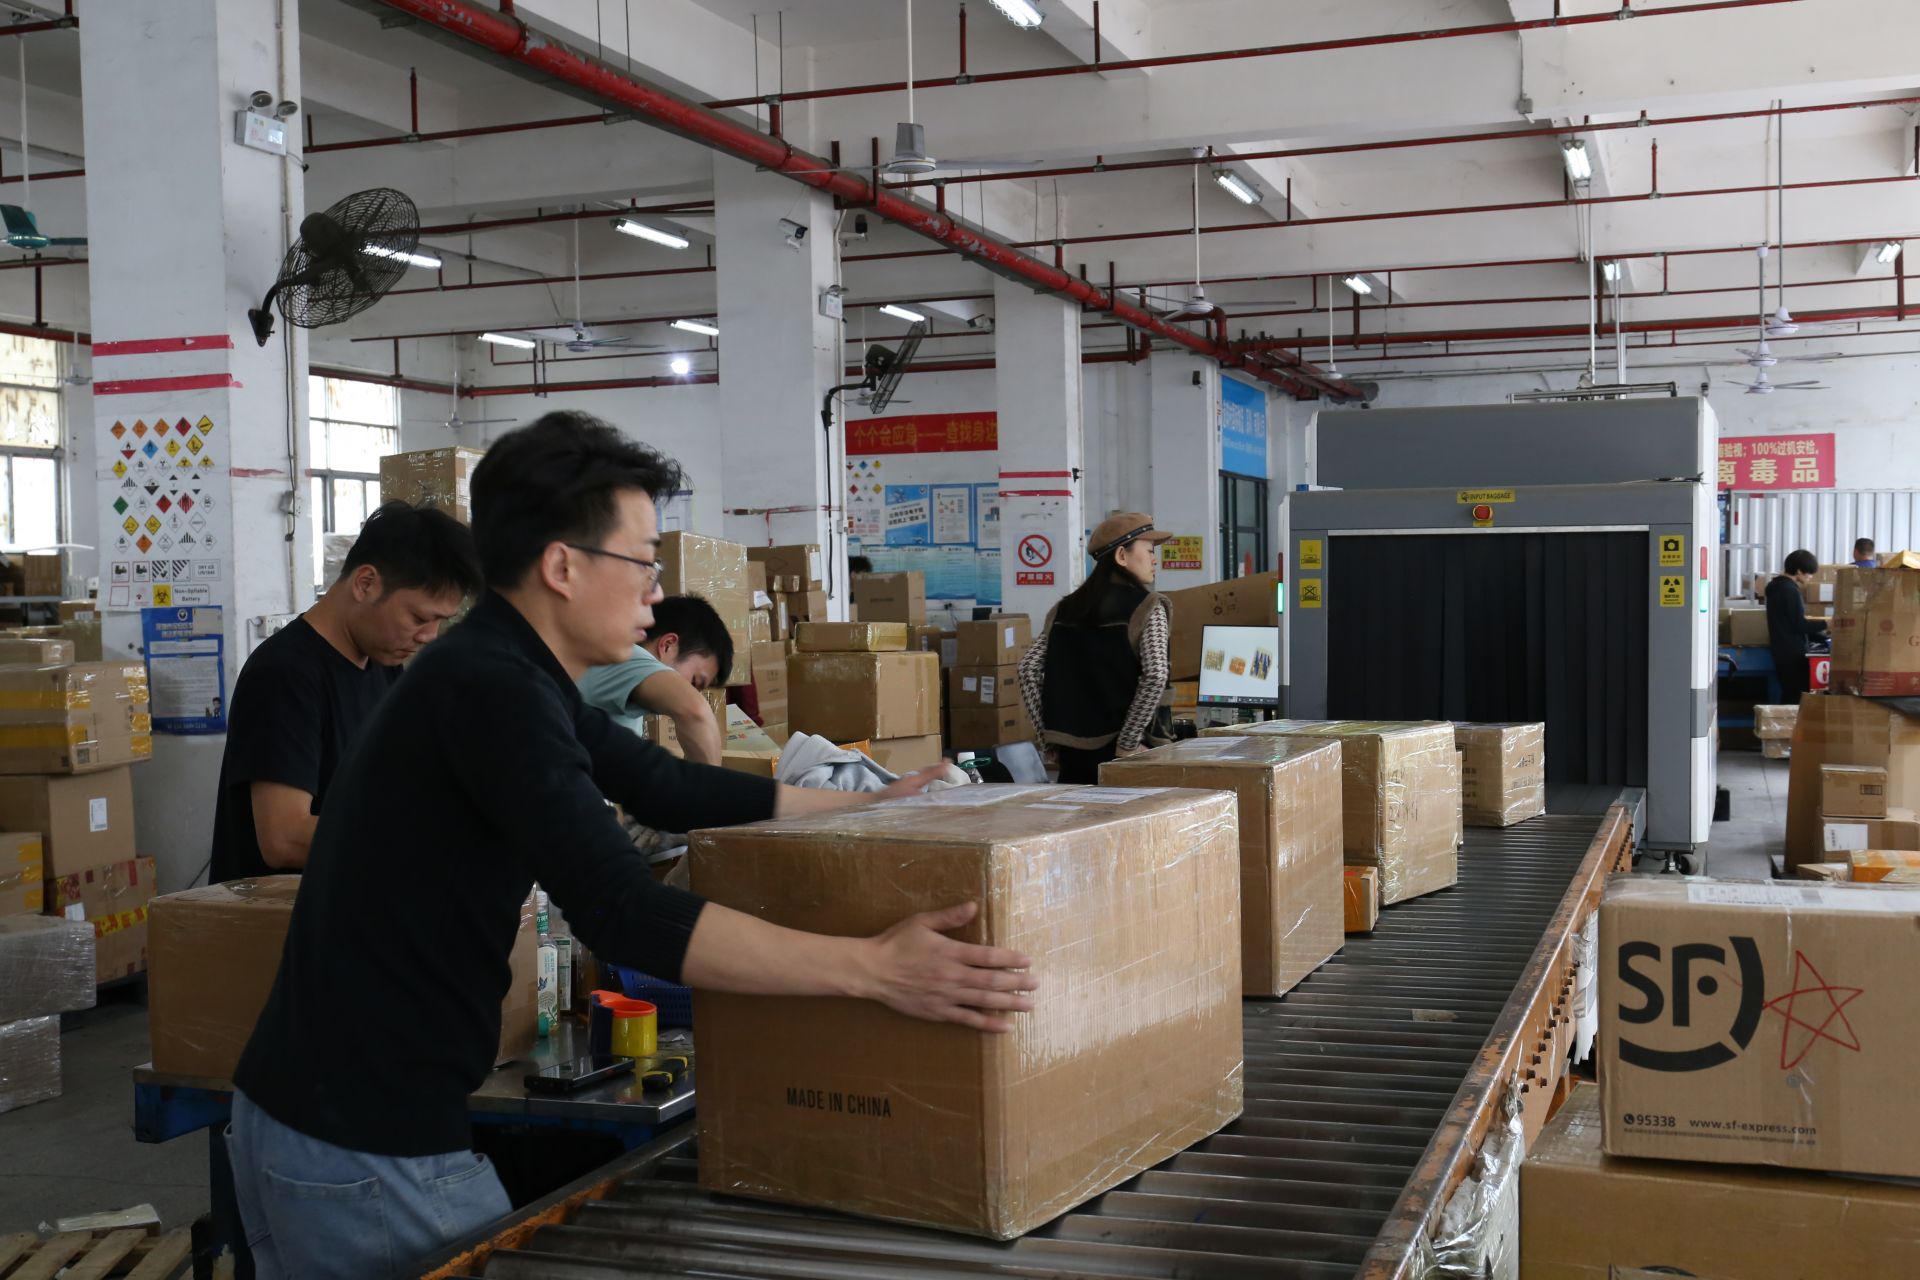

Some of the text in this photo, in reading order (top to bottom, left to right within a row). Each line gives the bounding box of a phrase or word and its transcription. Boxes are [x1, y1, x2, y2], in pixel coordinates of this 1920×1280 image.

[786, 1087, 892, 1118] MADE IN CHINA
[1636, 1114, 1817, 1136] 95338 www.sf-express.com
